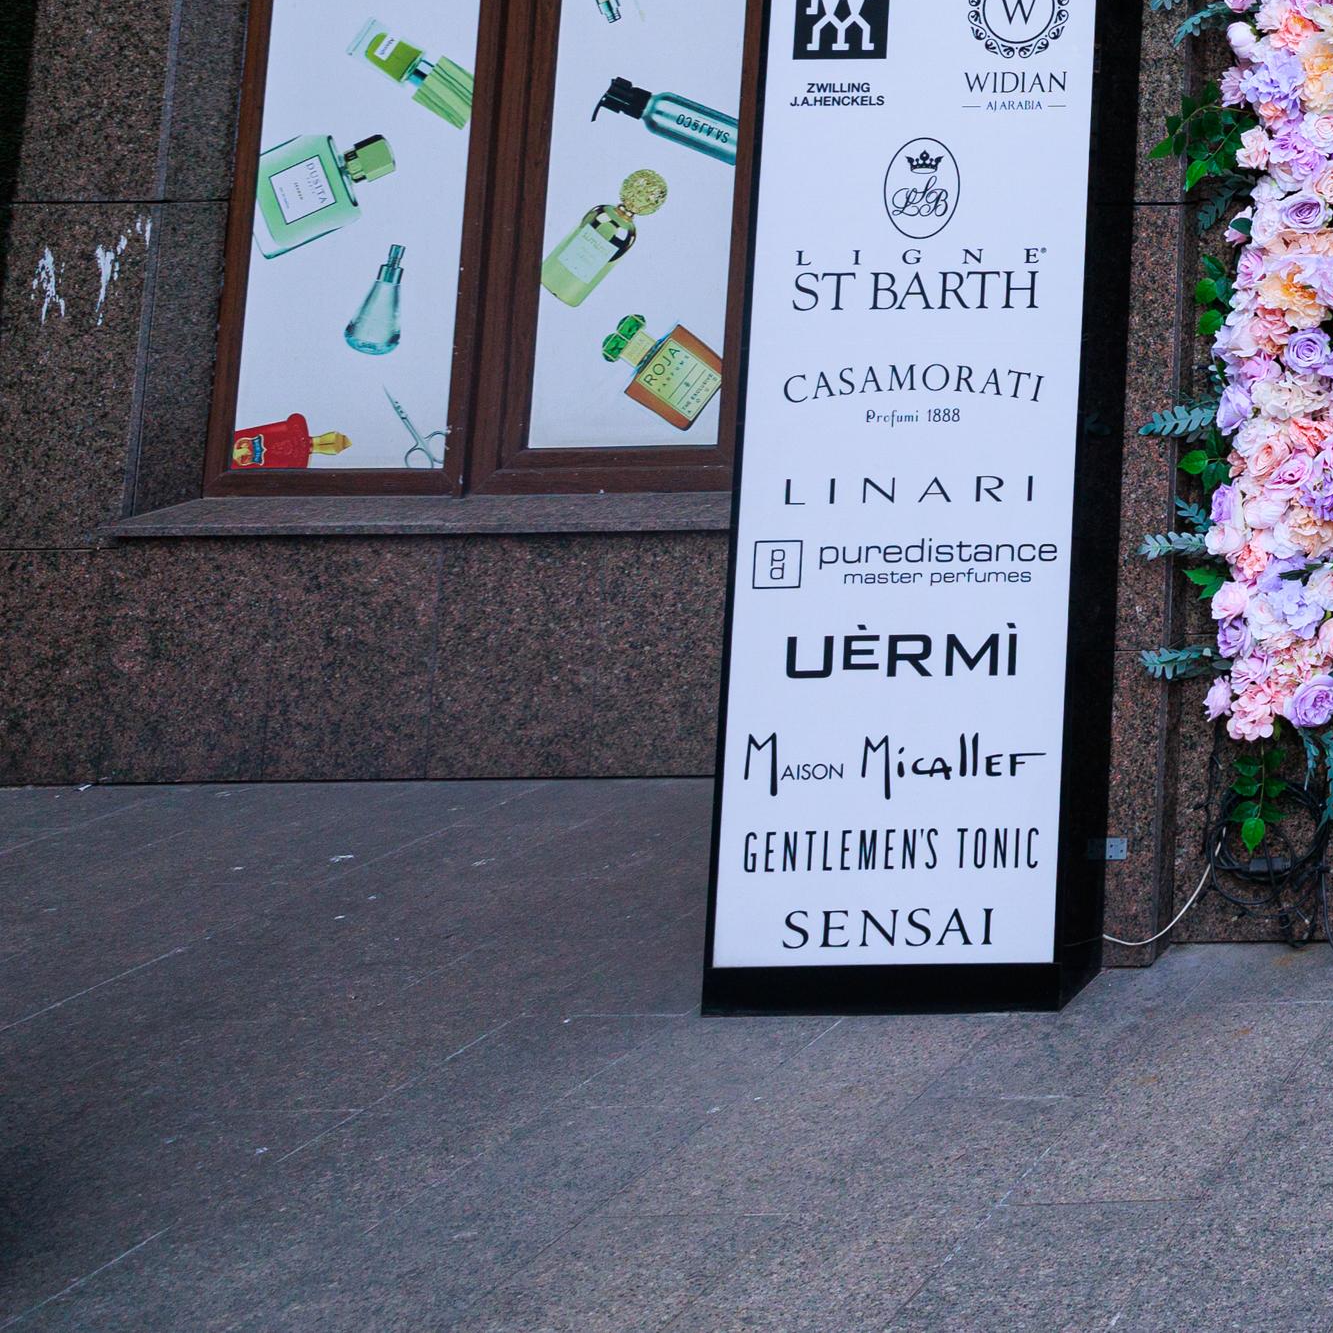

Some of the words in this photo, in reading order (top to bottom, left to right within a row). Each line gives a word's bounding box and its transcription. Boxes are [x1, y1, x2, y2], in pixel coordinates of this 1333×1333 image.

[806, 82, 871, 94] ZWILLING
[964, 71, 1068, 94] WIDIAN
[789, 95, 885, 107] J.A.HENCKELS
[986, 100, 997, 111] AJ
[999, 100, 1043, 110] ARABIA
[306, 162, 328, 204] DUSITA
[795, 247, 1041, 266] LIGNE
[791, 272, 856, 311] ST
[868, 270, 1039, 311] BARTH
[643, 347, 680, 386] ROJA
[783, 363, 1045, 404] CASAMORATI
[865, 409, 919, 428] Profumi
[927, 407, 961, 423] 1888
[784, 475, 1034, 506] LINARI
[818, 537, 1058, 570] puredistance
[843, 570, 923, 585] master
[929, 567, 1032, 587] perfumes
[743, 827, 939, 874] GENTLEMEN'S
[956, 827, 1040, 870] TONIC
[782, 907, 994, 950] SENSAI
